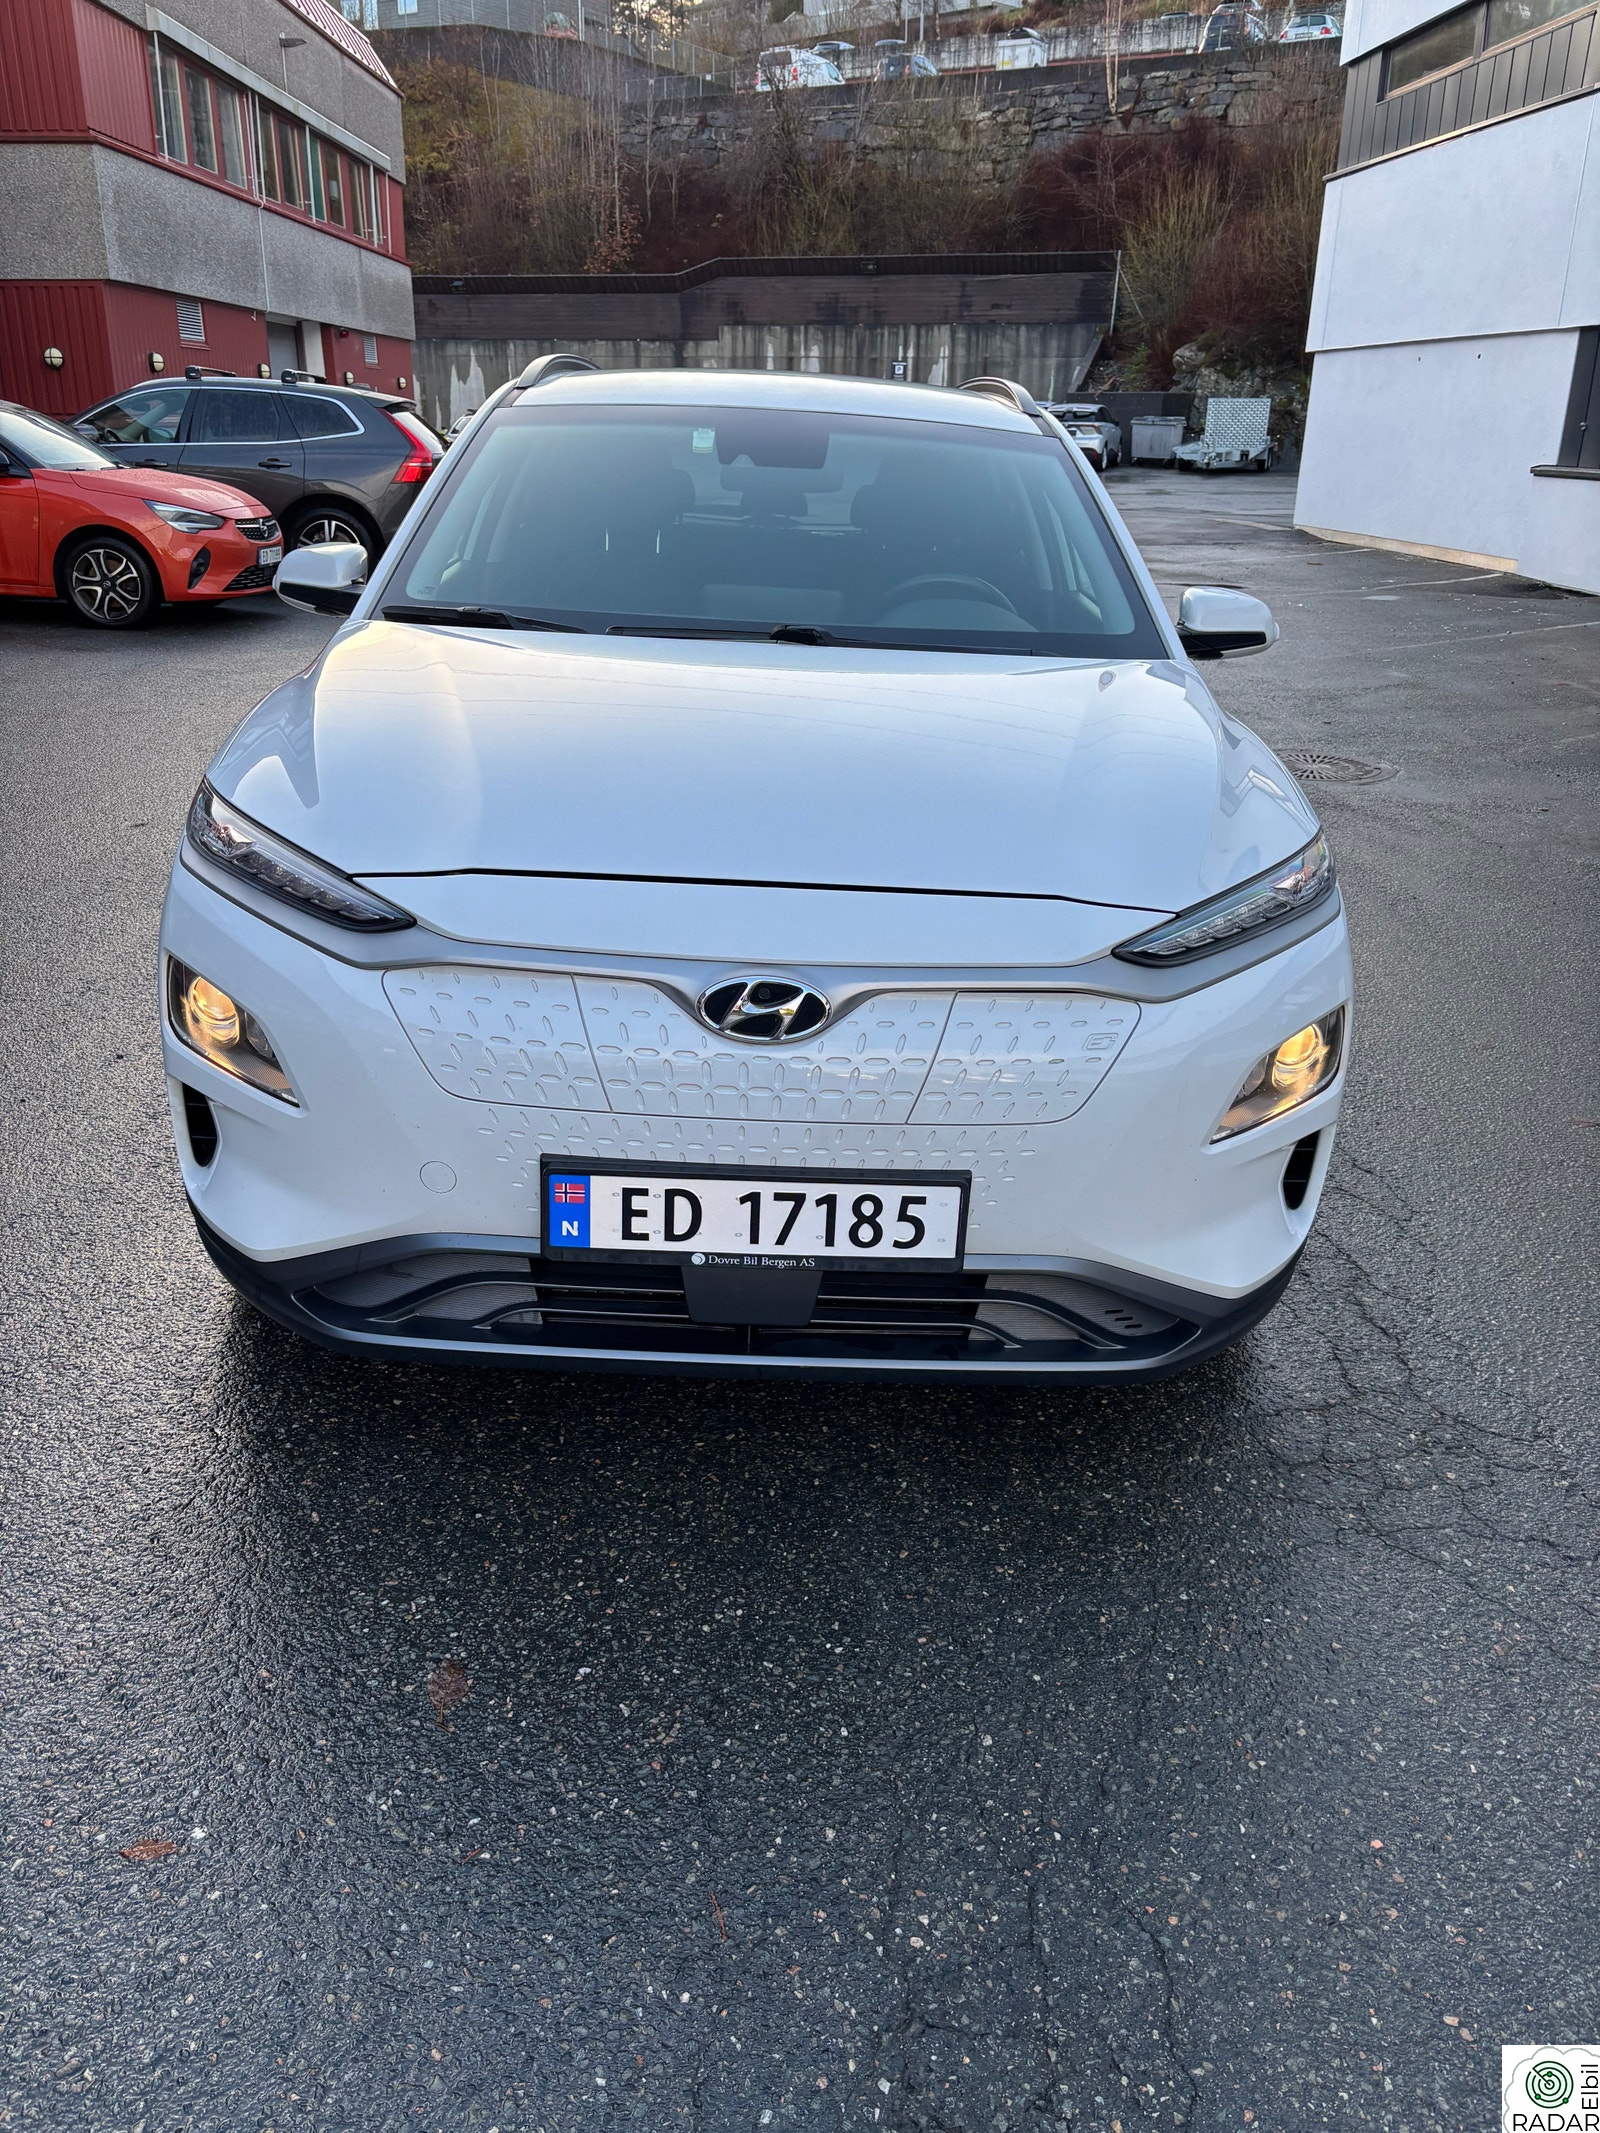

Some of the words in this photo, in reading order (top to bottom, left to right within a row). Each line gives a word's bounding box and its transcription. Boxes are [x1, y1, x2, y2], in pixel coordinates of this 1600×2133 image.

[621, 1186, 702, 1243] ED
[738, 1190, 928, 1249] 17185
[561, 1219, 579, 1237] N
[708, 1254, 740, 1265] Dovre
[743, 1256, 758, 1266] Bil
[761, 1257, 797, 1269] Bergen
[799, 1258, 816, 1267] AS
